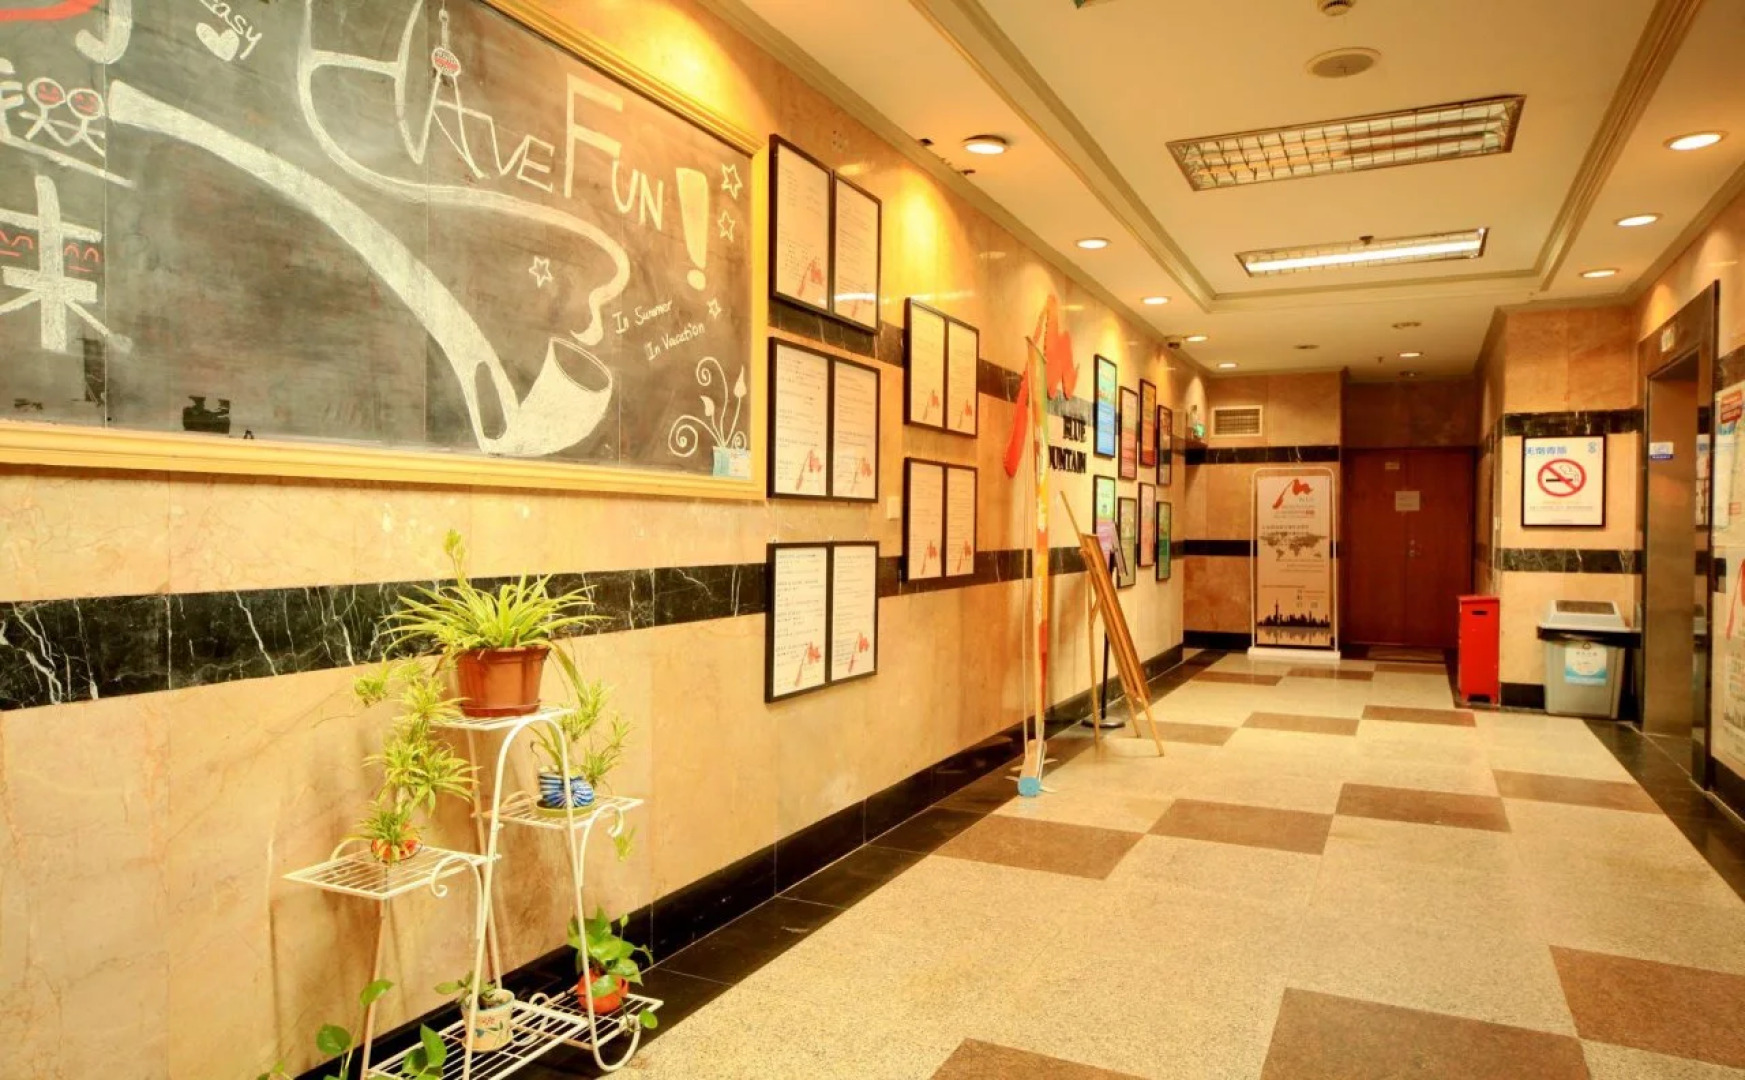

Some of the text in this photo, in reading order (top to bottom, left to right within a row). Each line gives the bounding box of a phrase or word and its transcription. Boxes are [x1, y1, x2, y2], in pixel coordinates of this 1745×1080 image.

[200, 0, 262, 60] asy
[612, 299, 673, 334] In Summer
[644, 322, 706, 361] In Vacation
